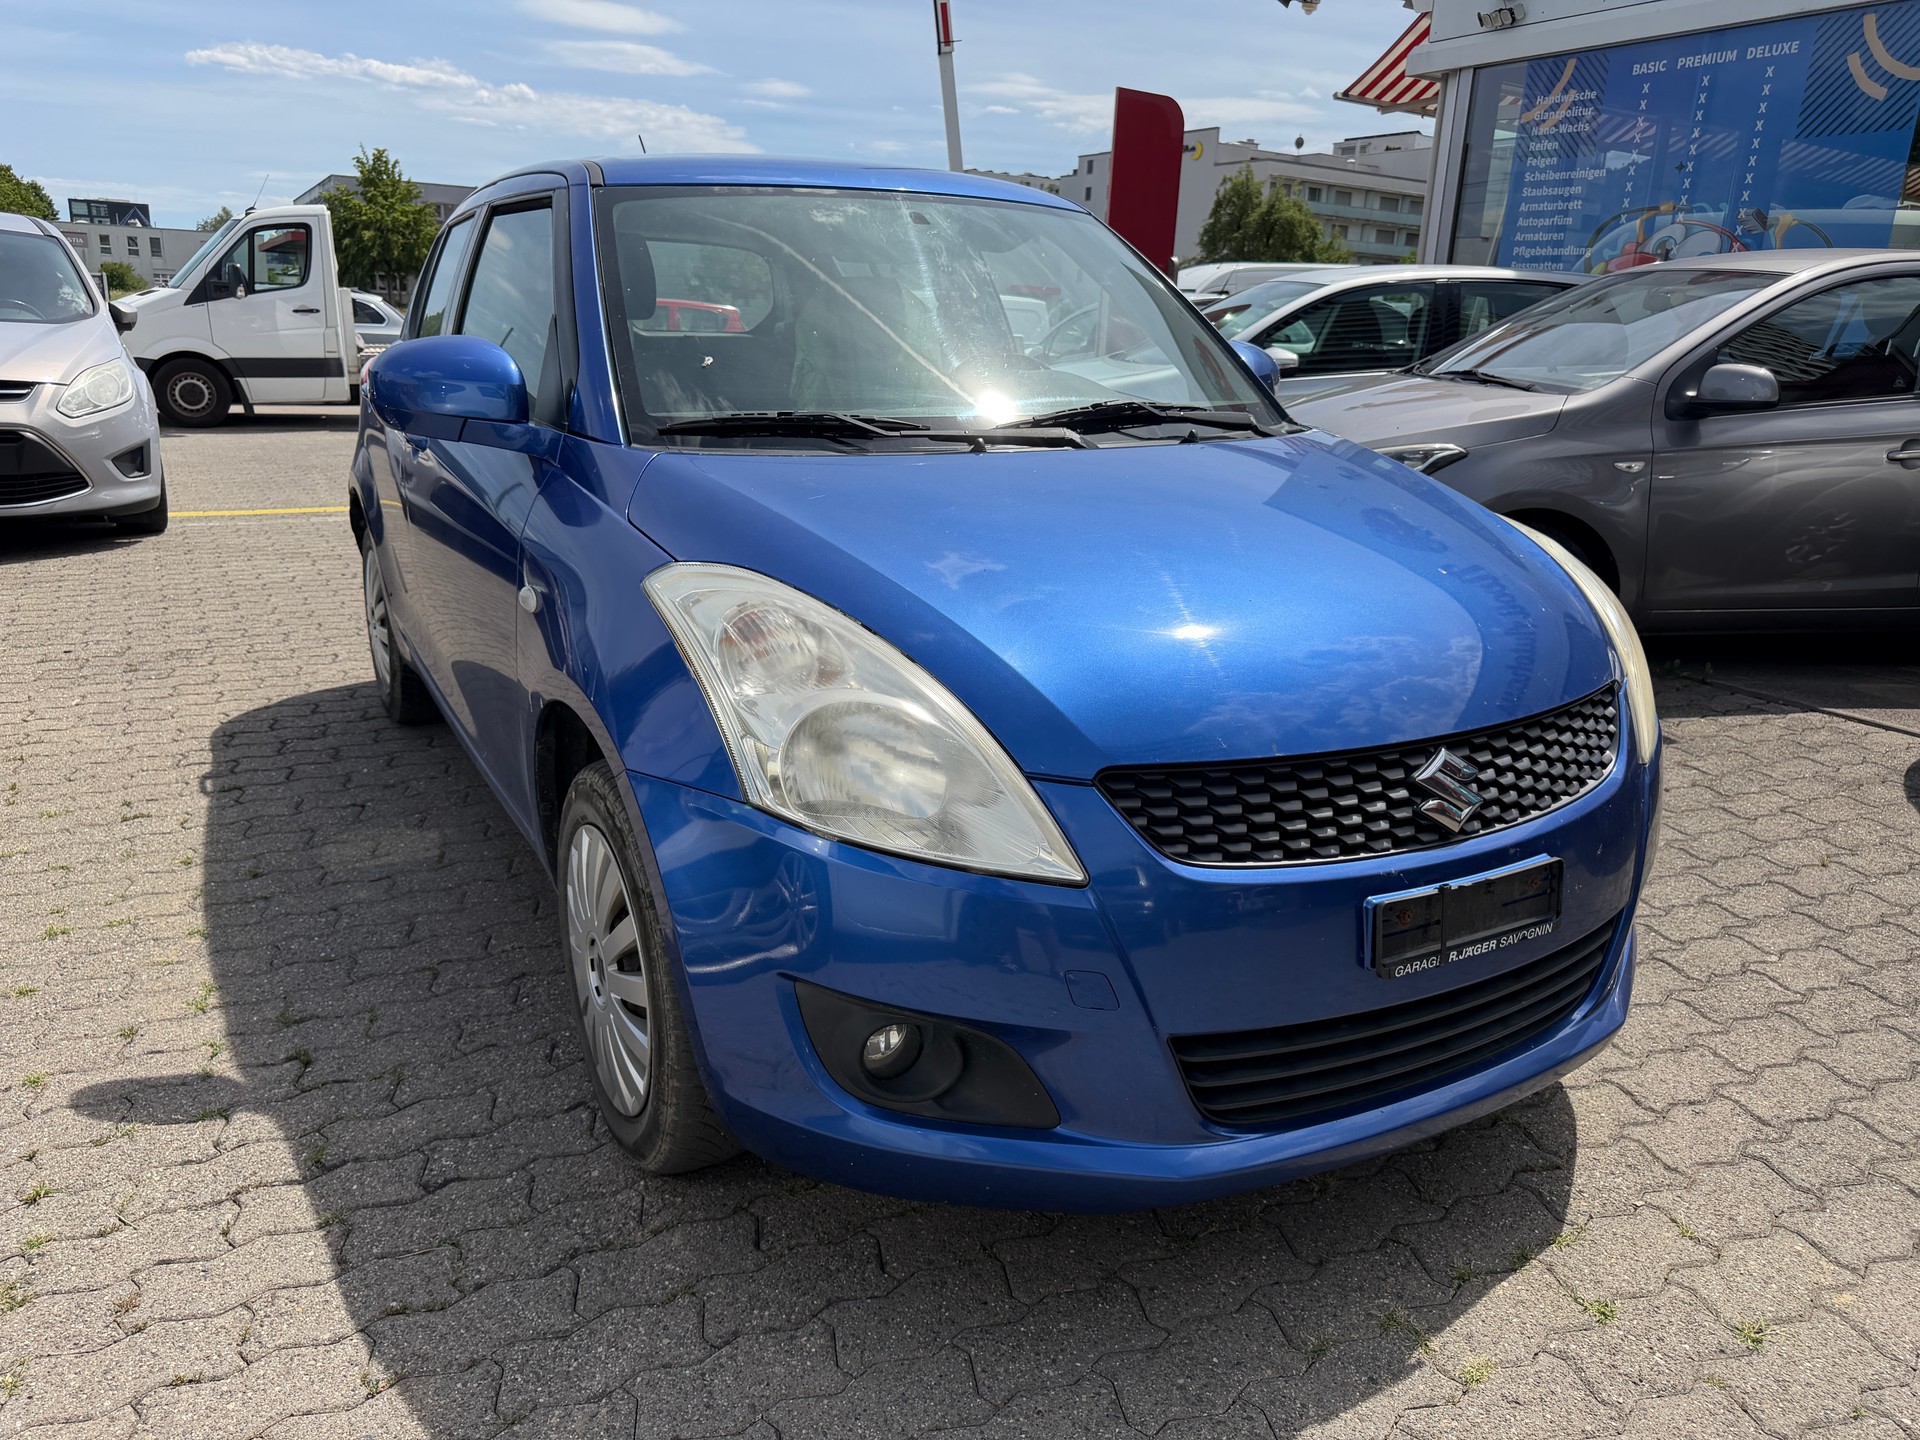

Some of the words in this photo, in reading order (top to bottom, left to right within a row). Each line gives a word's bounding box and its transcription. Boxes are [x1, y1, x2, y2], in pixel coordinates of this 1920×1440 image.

[1632, 60, 1667, 75] BASIC
[1677, 49, 1738, 69] PREMIUM
[1746, 41, 1800, 59] DELUXE
[1536, 89, 1597, 105] Handwäsche
[1534, 106, 1594, 121] Glanzpolitur
[1531, 122, 1589, 136] Nano-Wachs
[1529, 140, 1559, 151] Reifen
[1526, 157, 1557, 168] Felgen
[1524, 168, 1606, 181] Scheibenreinigen
[1521, 186, 1582, 197] Staubsaugen
[1519, 200, 1582, 212] Armaturbrett
[1517, 215, 1572, 228] Autoparfüm
[1514, 232, 1564, 241] Armaturen
